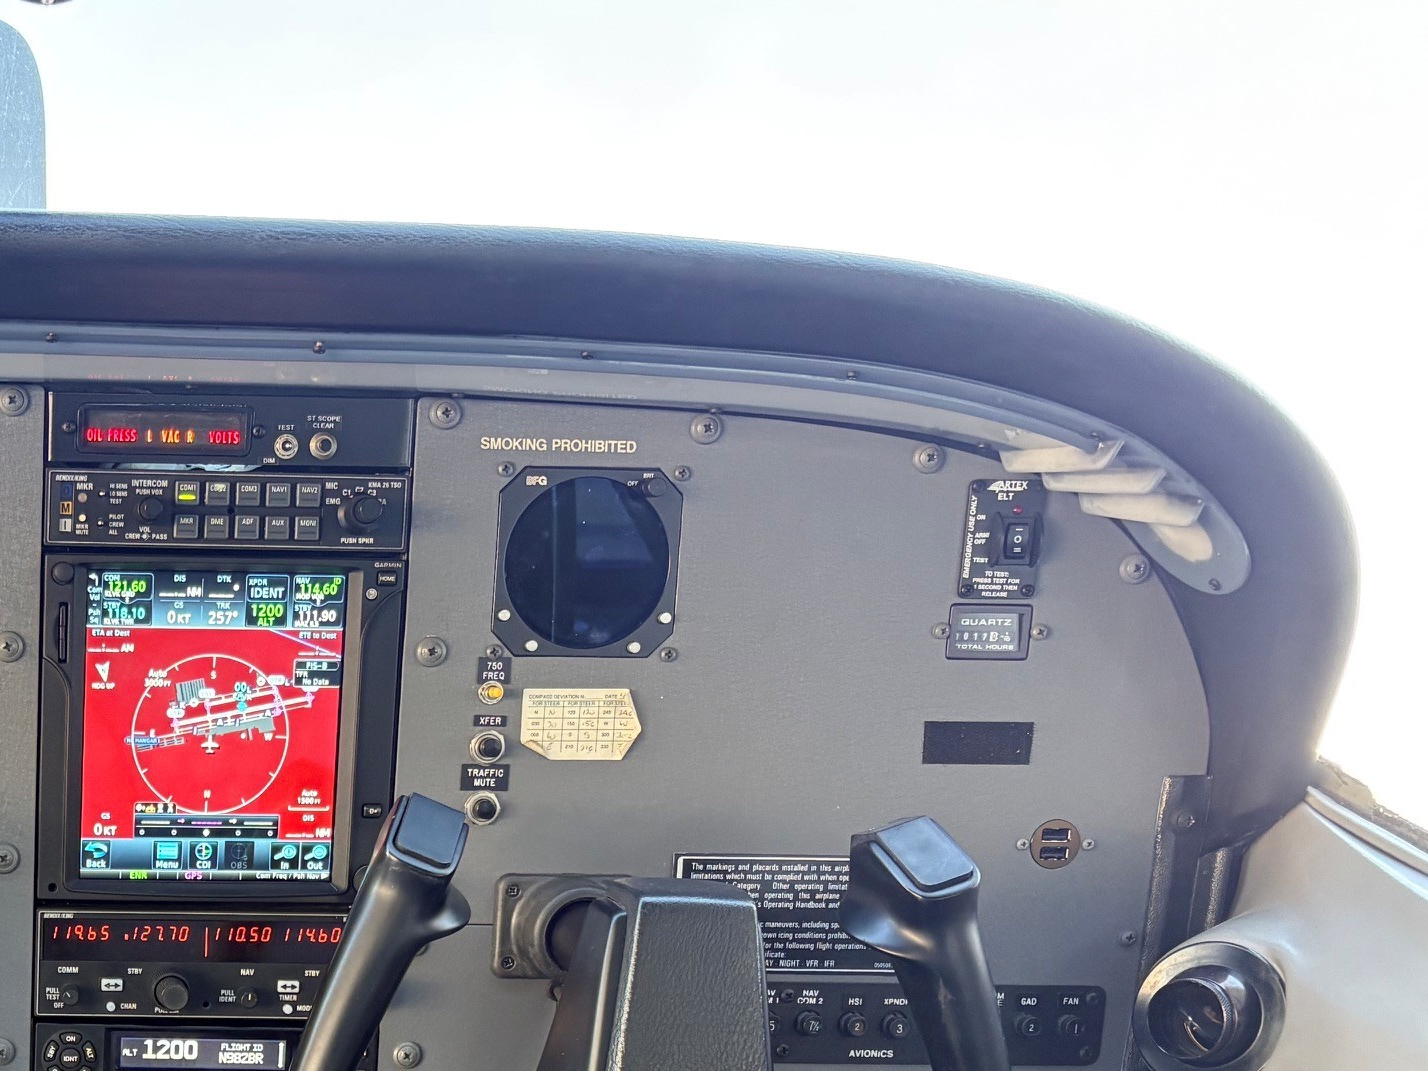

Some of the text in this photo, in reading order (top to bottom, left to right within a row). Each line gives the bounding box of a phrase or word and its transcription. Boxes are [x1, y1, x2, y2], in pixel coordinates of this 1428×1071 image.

[481, 437, 637, 453] SMOKING PROHIBITED
[131, 480, 168, 488] INTERCOM
[999, 481, 1028, 490] ARTEX
[998, 493, 1014, 501] ELT
[963, 532, 974, 579] EMERGENCY
[969, 495, 978, 515] ONLY
[108, 581, 146, 592] 121.60
[250, 588, 285, 599] IDENT
[107, 608, 145, 619] 118.10
[251, 604, 284, 616] 1200
[257, 618, 274, 626] ALT
[487, 662, 502, 670] 750
[483, 672, 505, 680] FREQ
[479, 717, 501, 725] XFER
[467, 768, 504, 777] TRAFFIC
[473, 778, 496, 787] MUTE
[156, 860, 179, 869] Menu
[185, 871, 202, 880] GPS
[53, 925, 110, 940] 119.65
[132, 926, 190, 941] 127.70
[215, 927, 272, 942] 110.50
[58, 966, 79, 974] COMM
[240, 968, 254, 976] NAV
[848, 998, 862, 1006] HSI
[1063, 998, 1079, 1006] FAN
[142, 1039, 198, 1060] 1200
[221, 1043, 250, 1051] FLIGHT
[848, 1050, 894, 1058] AVIONICS
[219, 1053, 263, 1065] N982BR
